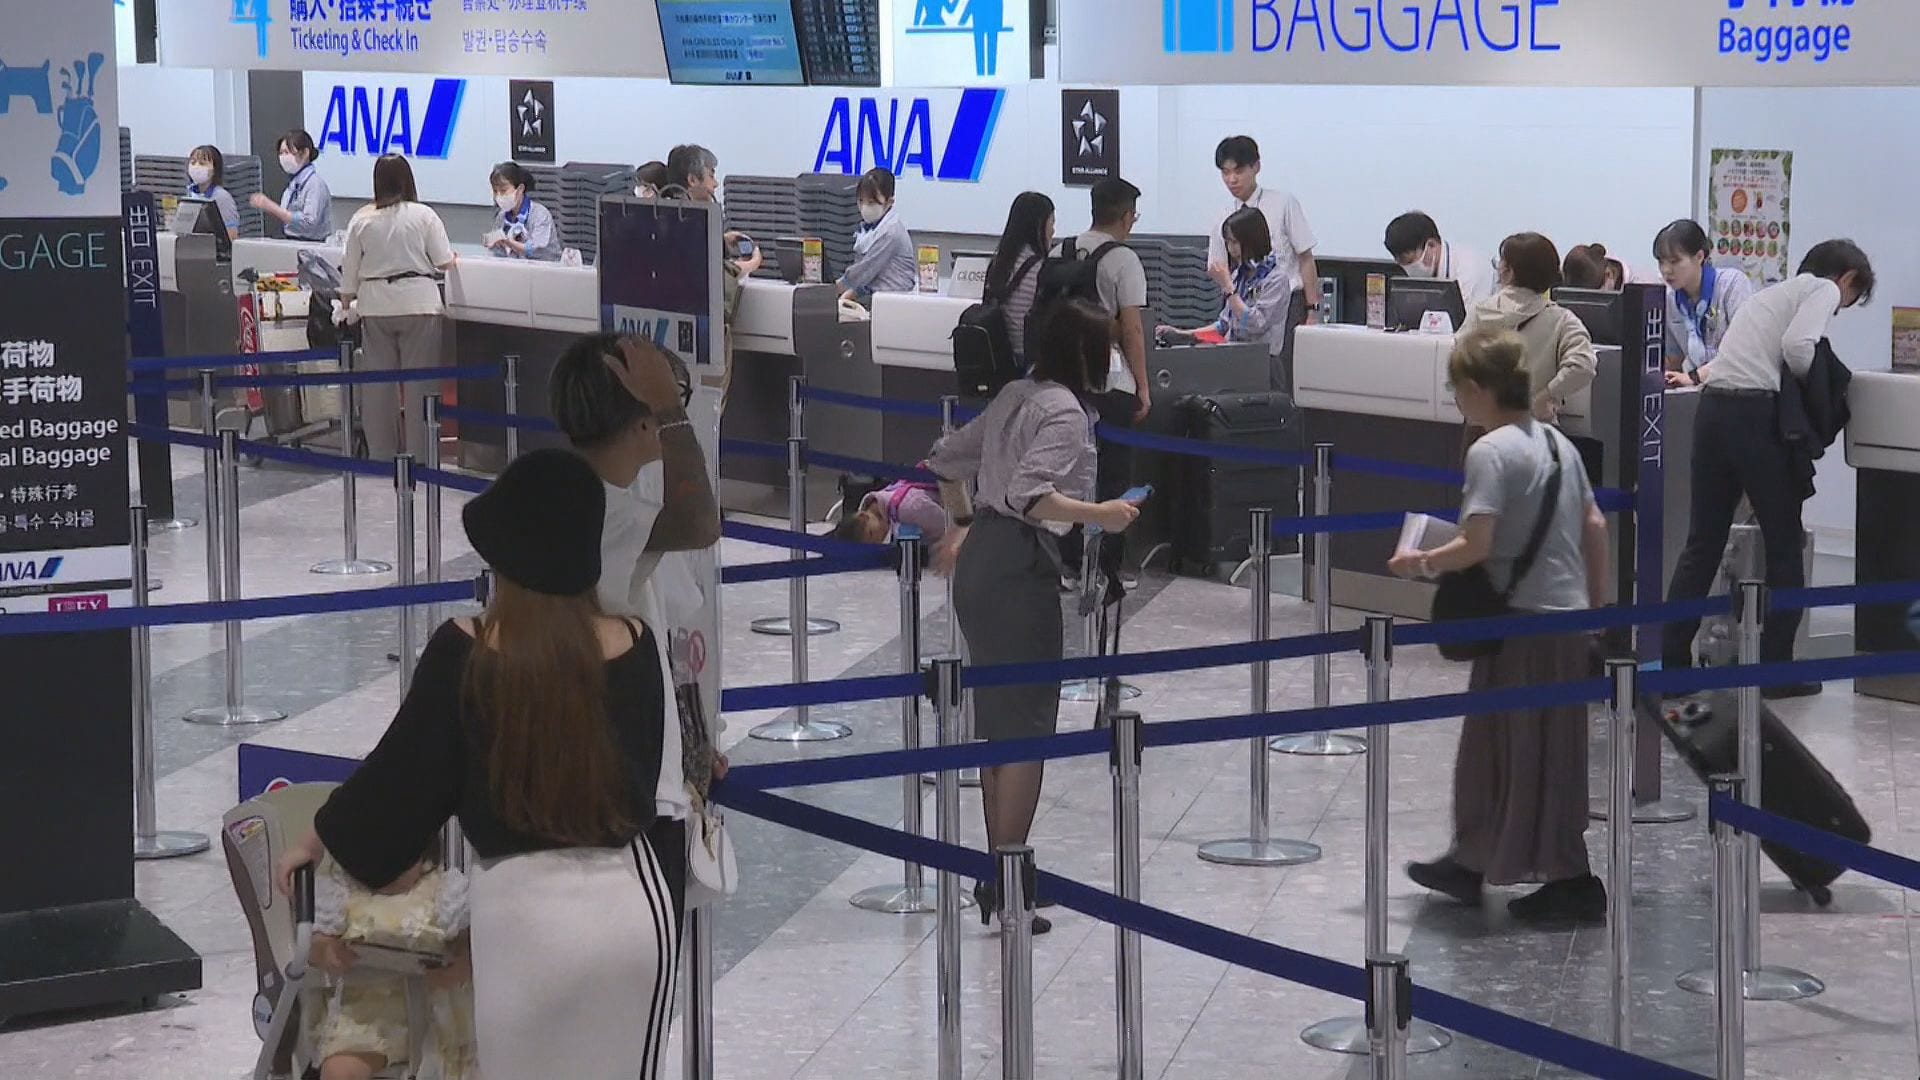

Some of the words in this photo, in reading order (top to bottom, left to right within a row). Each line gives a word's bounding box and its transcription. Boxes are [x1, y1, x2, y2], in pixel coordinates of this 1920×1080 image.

[290, 27, 348, 56] Ticketing
[351, 28, 361, 50] &
[363, 27, 403, 51] Check
[406, 28, 418, 51] In
[1252, 0, 1561, 51] BAGGAGE
[1719, 18, 1850, 62] Baggage
[318, 85, 413, 155] ANA
[813, 97, 934, 178] ANA
[129, 205, 151, 248] 出口
[131, 259, 157, 309] EXIT
[1645, 307, 1663, 375] 出口
[30, 418, 118, 441] Baggage
[1642, 392, 1663, 468] EXIT
[22, 447, 111, 469] Baggage
[0, 560, 37, 581] NA
